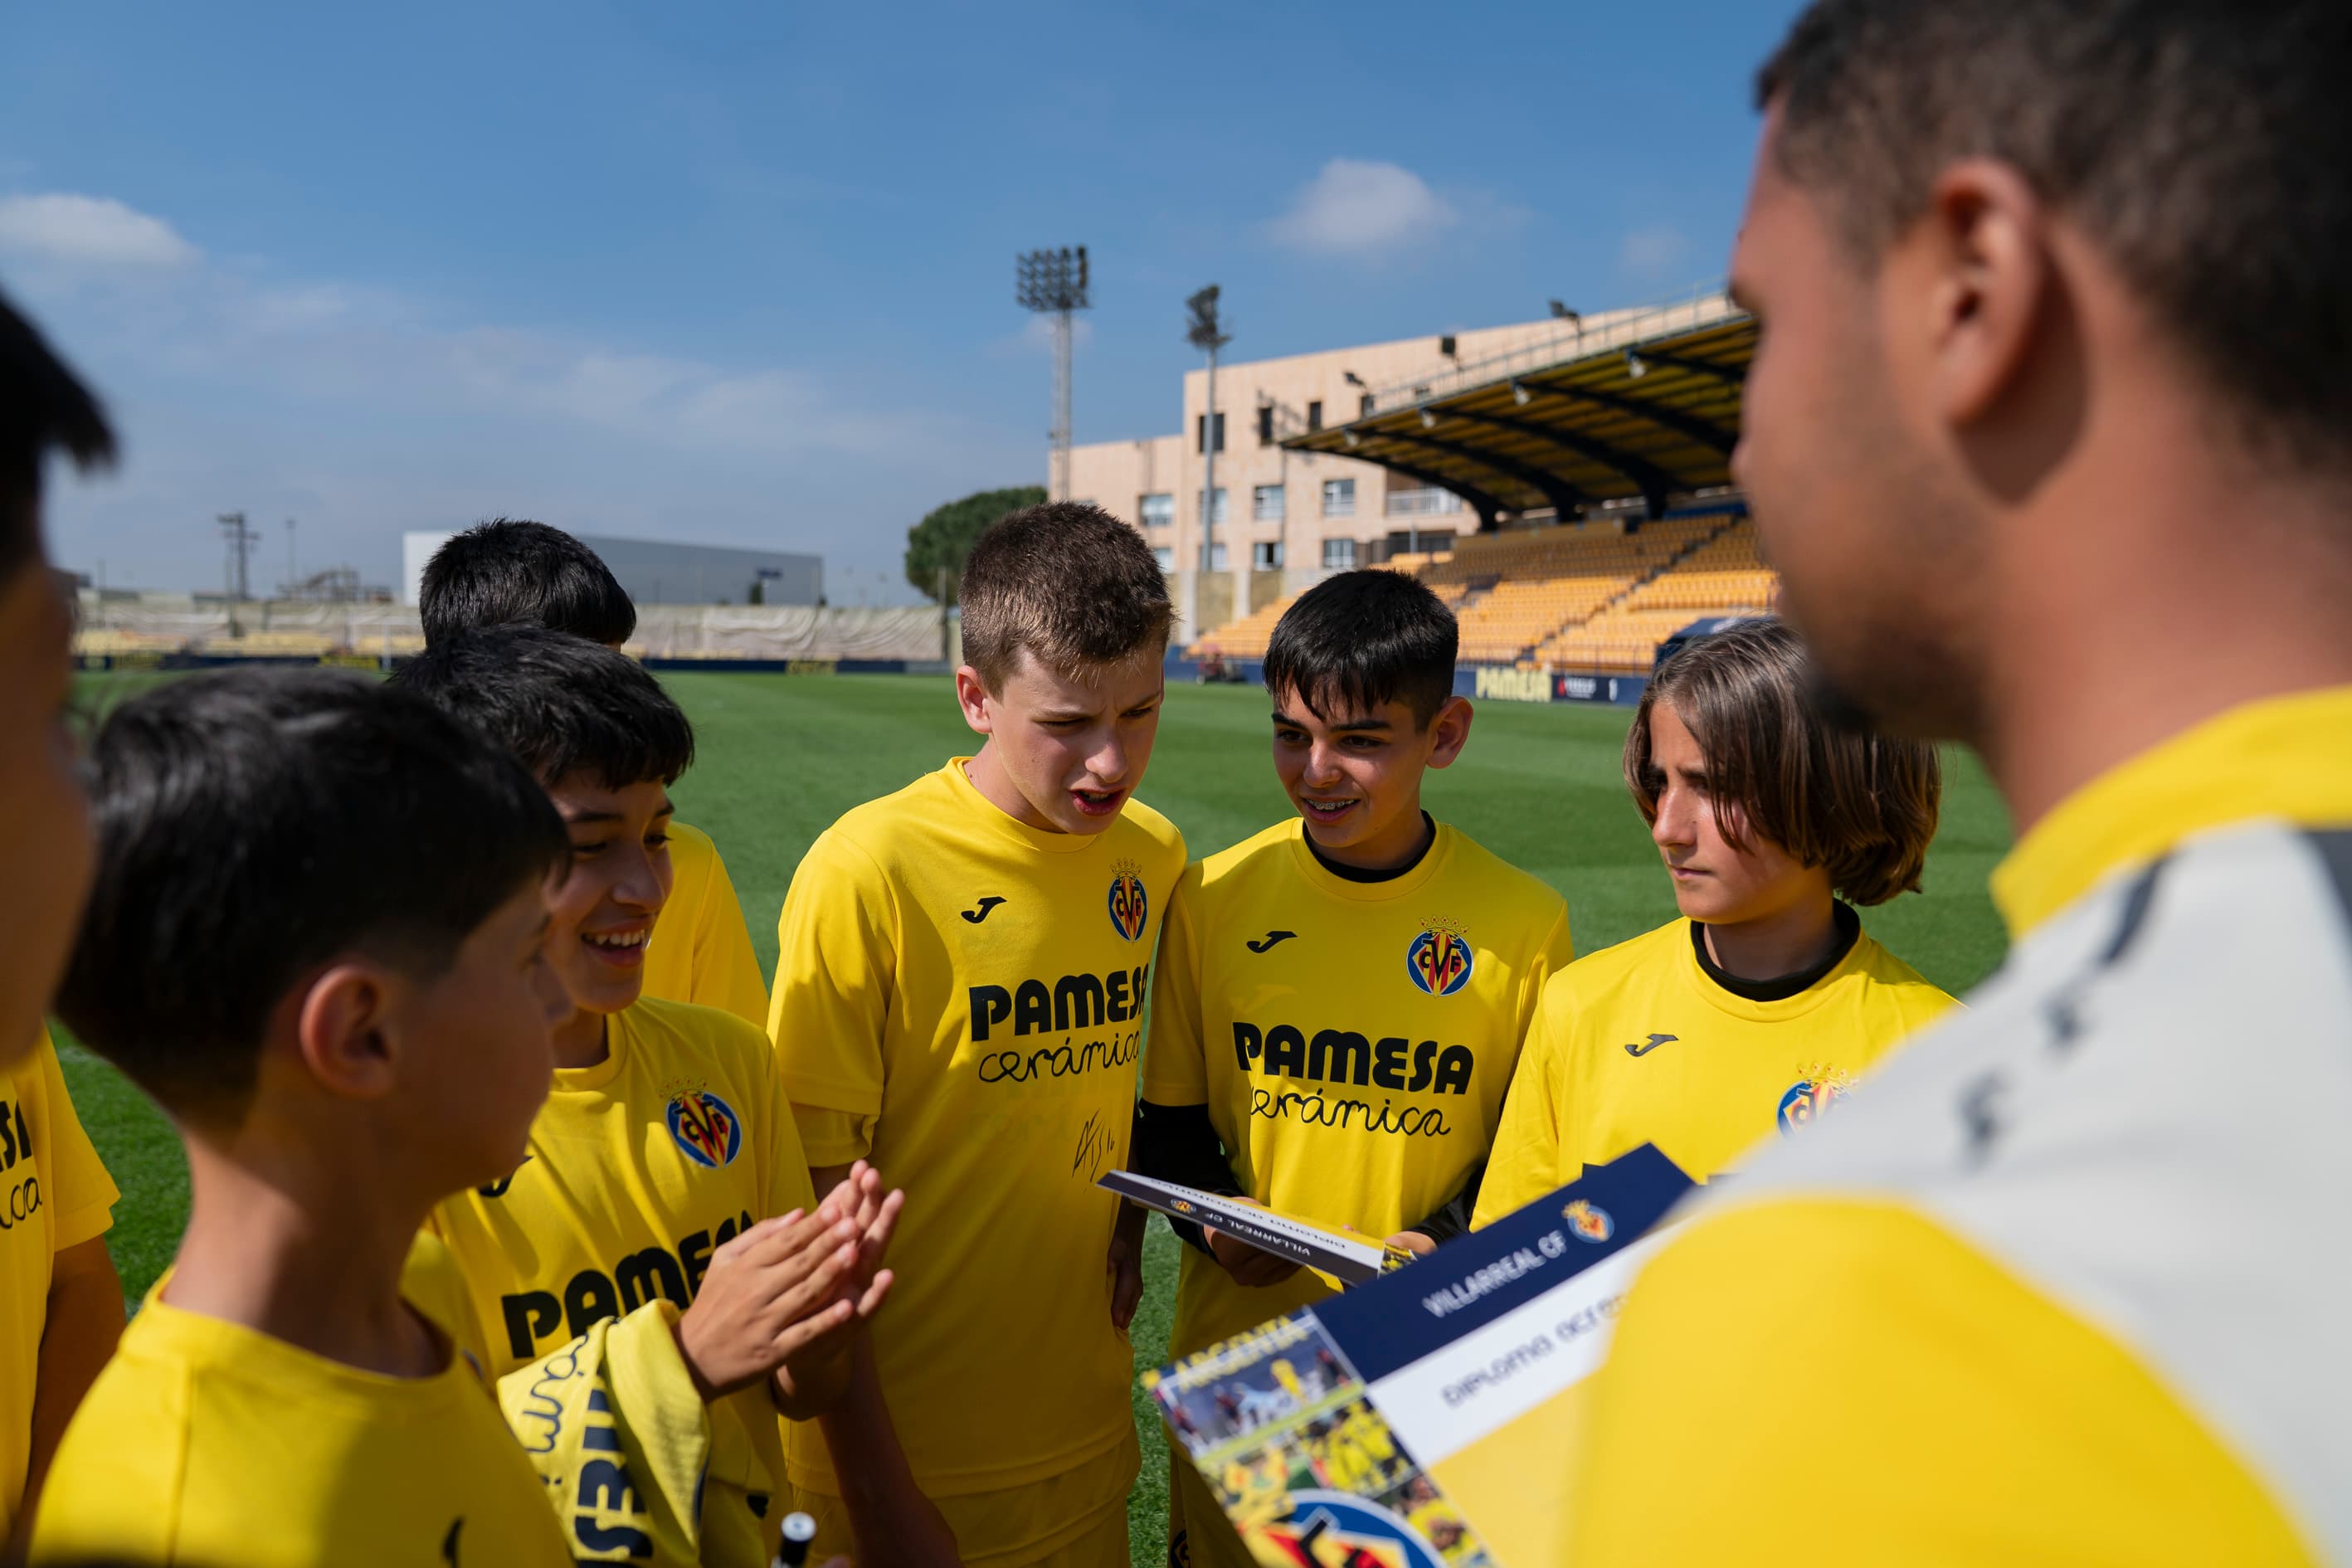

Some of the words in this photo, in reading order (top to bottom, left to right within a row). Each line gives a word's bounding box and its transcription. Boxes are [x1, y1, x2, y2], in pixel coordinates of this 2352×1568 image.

[1232, 1021, 1474, 1095] PAMESA
[1230, 1221, 1311, 1256] VILLARREAL
[1421, 1247, 1546, 1318] VILLARREAL
[1537, 1230, 1566, 1259] CF
[501, 1210, 756, 1359] PAME
